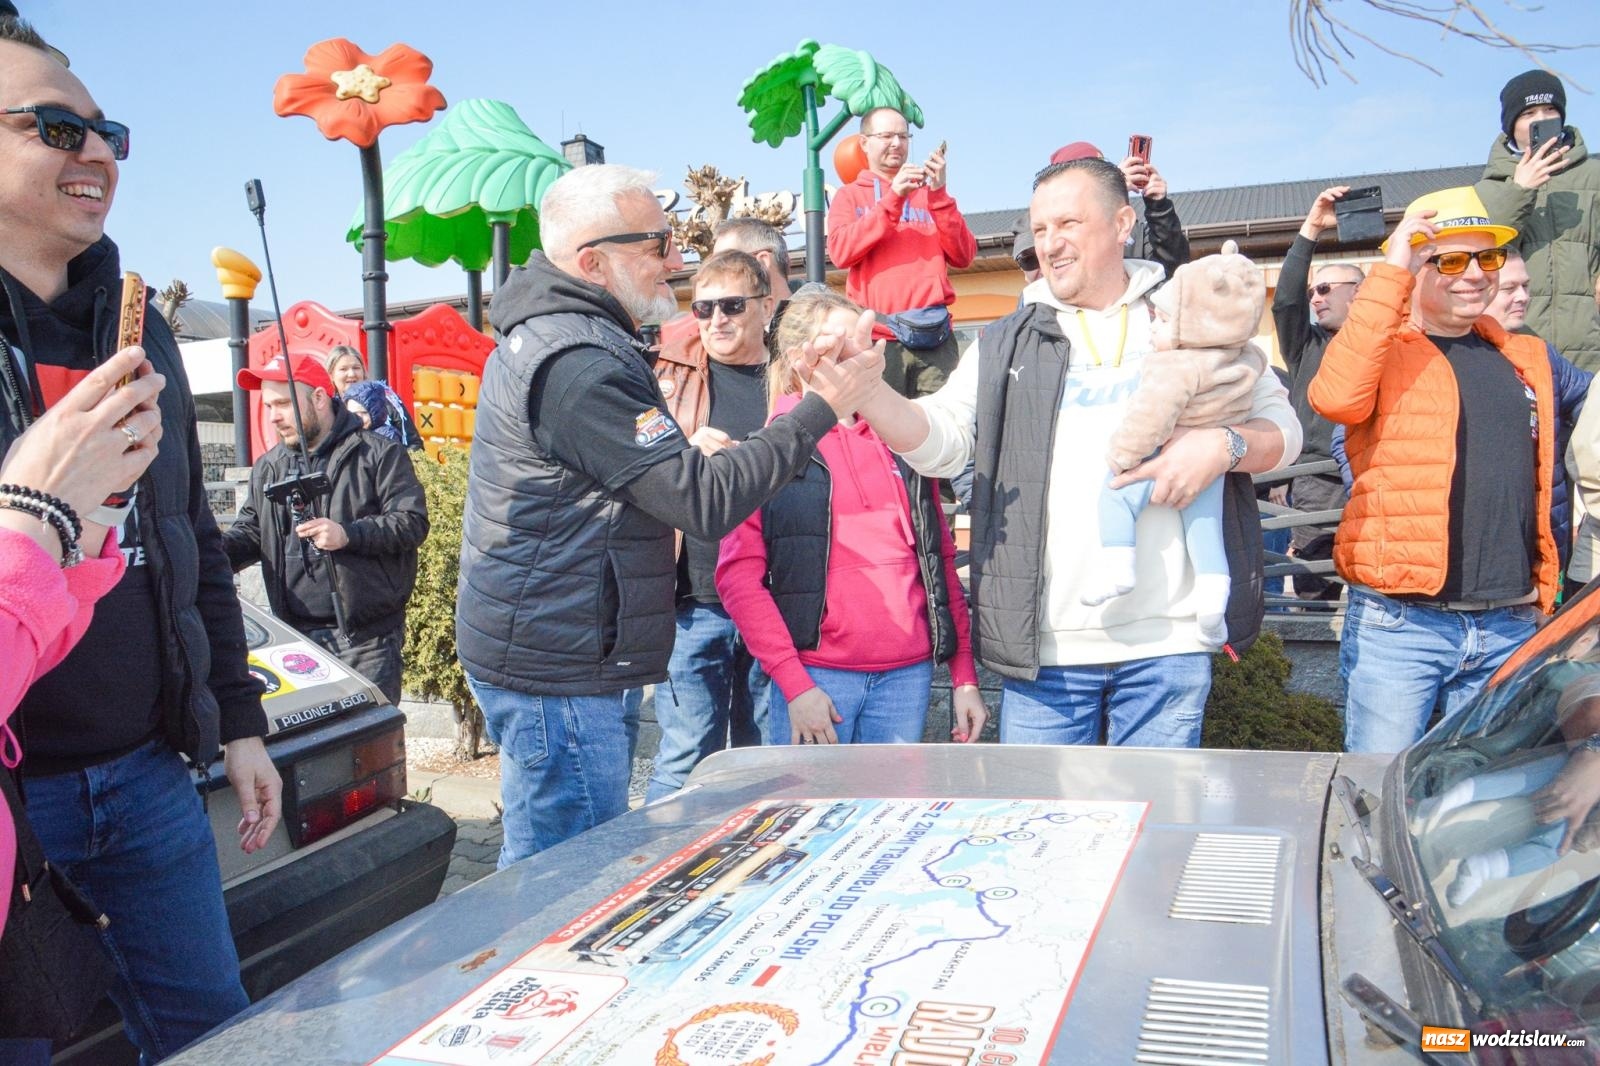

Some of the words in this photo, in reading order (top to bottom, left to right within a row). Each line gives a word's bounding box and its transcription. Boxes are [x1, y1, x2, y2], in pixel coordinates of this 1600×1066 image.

[282, 703, 336, 727] POLONEZ
[340, 693, 368, 710] 1500
[829, 895, 860, 910] DO
[861, 923, 902, 963] UZBEKISTAN
[725, 958, 760, 985] TBILISI
[932, 941, 972, 990] KAZAKHSTAN
[683, 1023, 716, 1047] DZIECI
